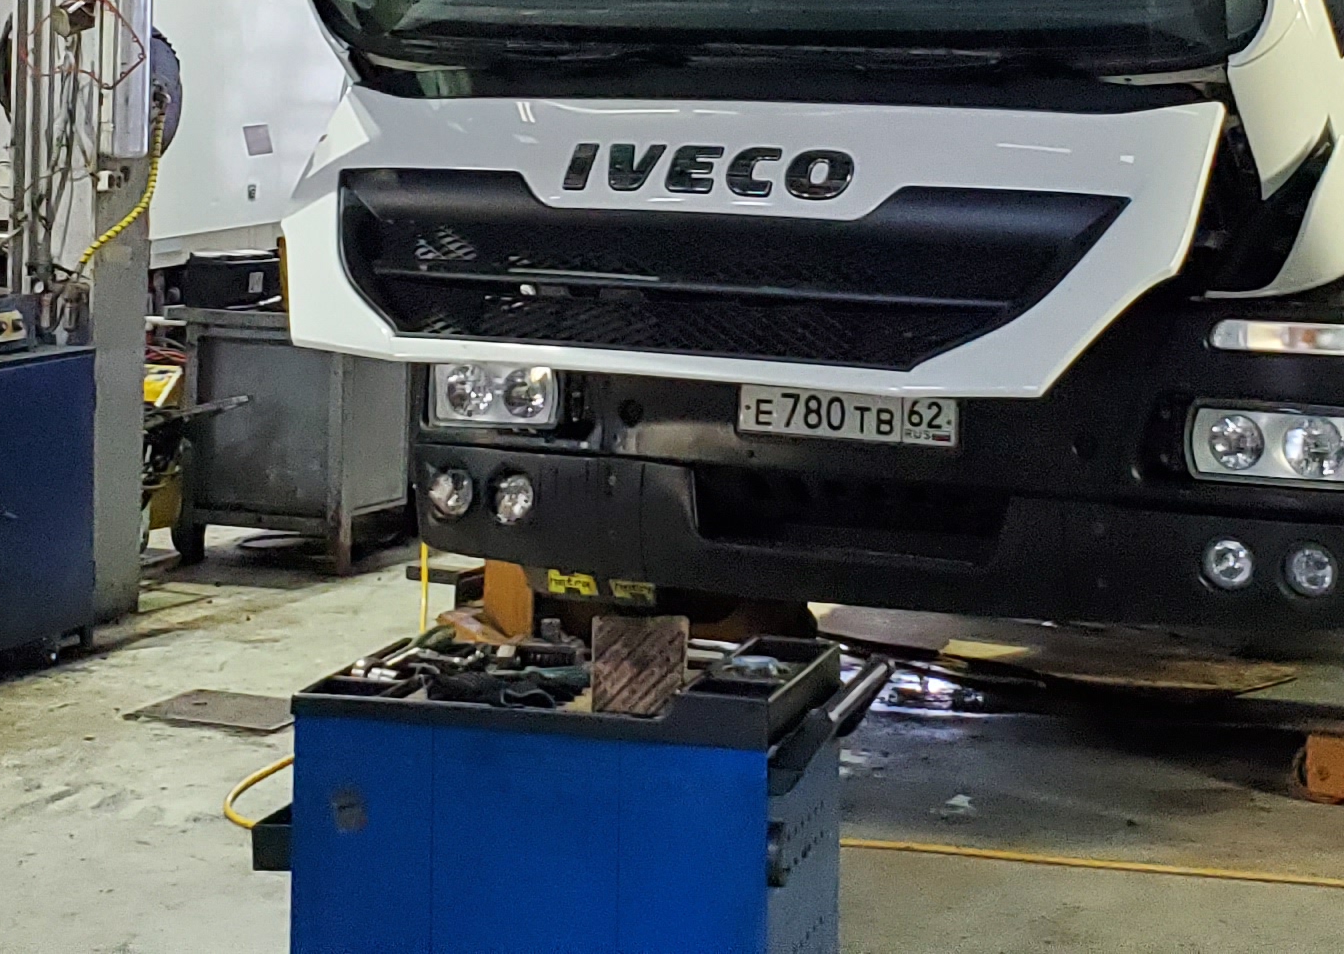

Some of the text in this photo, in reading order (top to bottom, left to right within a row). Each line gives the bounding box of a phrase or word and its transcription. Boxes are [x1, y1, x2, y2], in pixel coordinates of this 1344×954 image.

[562, 143, 854, 200] IVECO
[907, 400, 942, 429] 62
[905, 428, 931, 440] RUS
